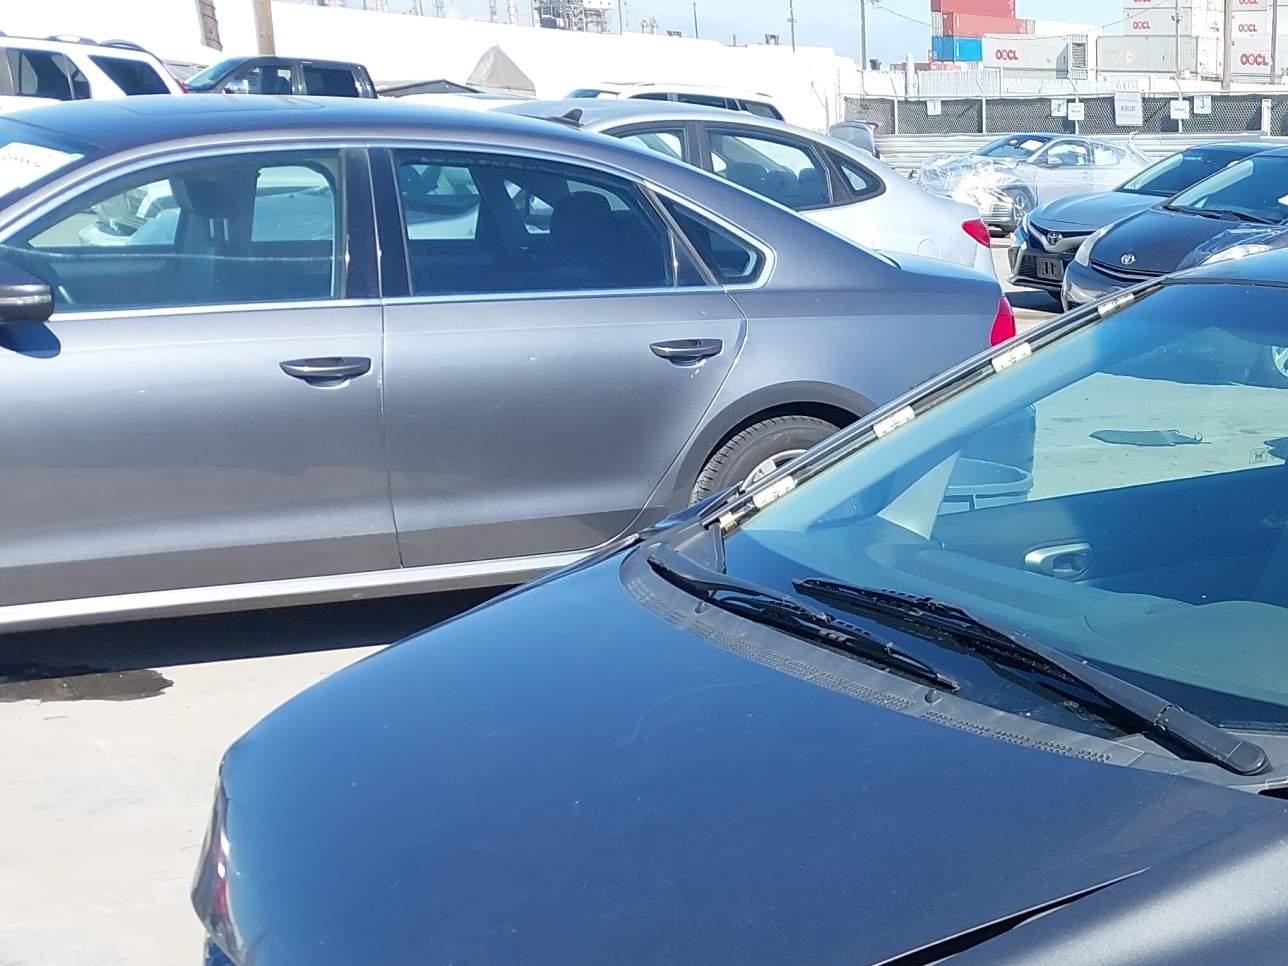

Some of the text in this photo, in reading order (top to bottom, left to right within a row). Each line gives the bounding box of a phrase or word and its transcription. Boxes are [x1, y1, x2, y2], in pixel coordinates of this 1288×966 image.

[1133, 21, 1151, 30] OOCL
[1238, 23, 1258, 33] OOCL
[995, 49, 1019, 60] OOCL
[1240, 52, 1269, 67] OOCL
